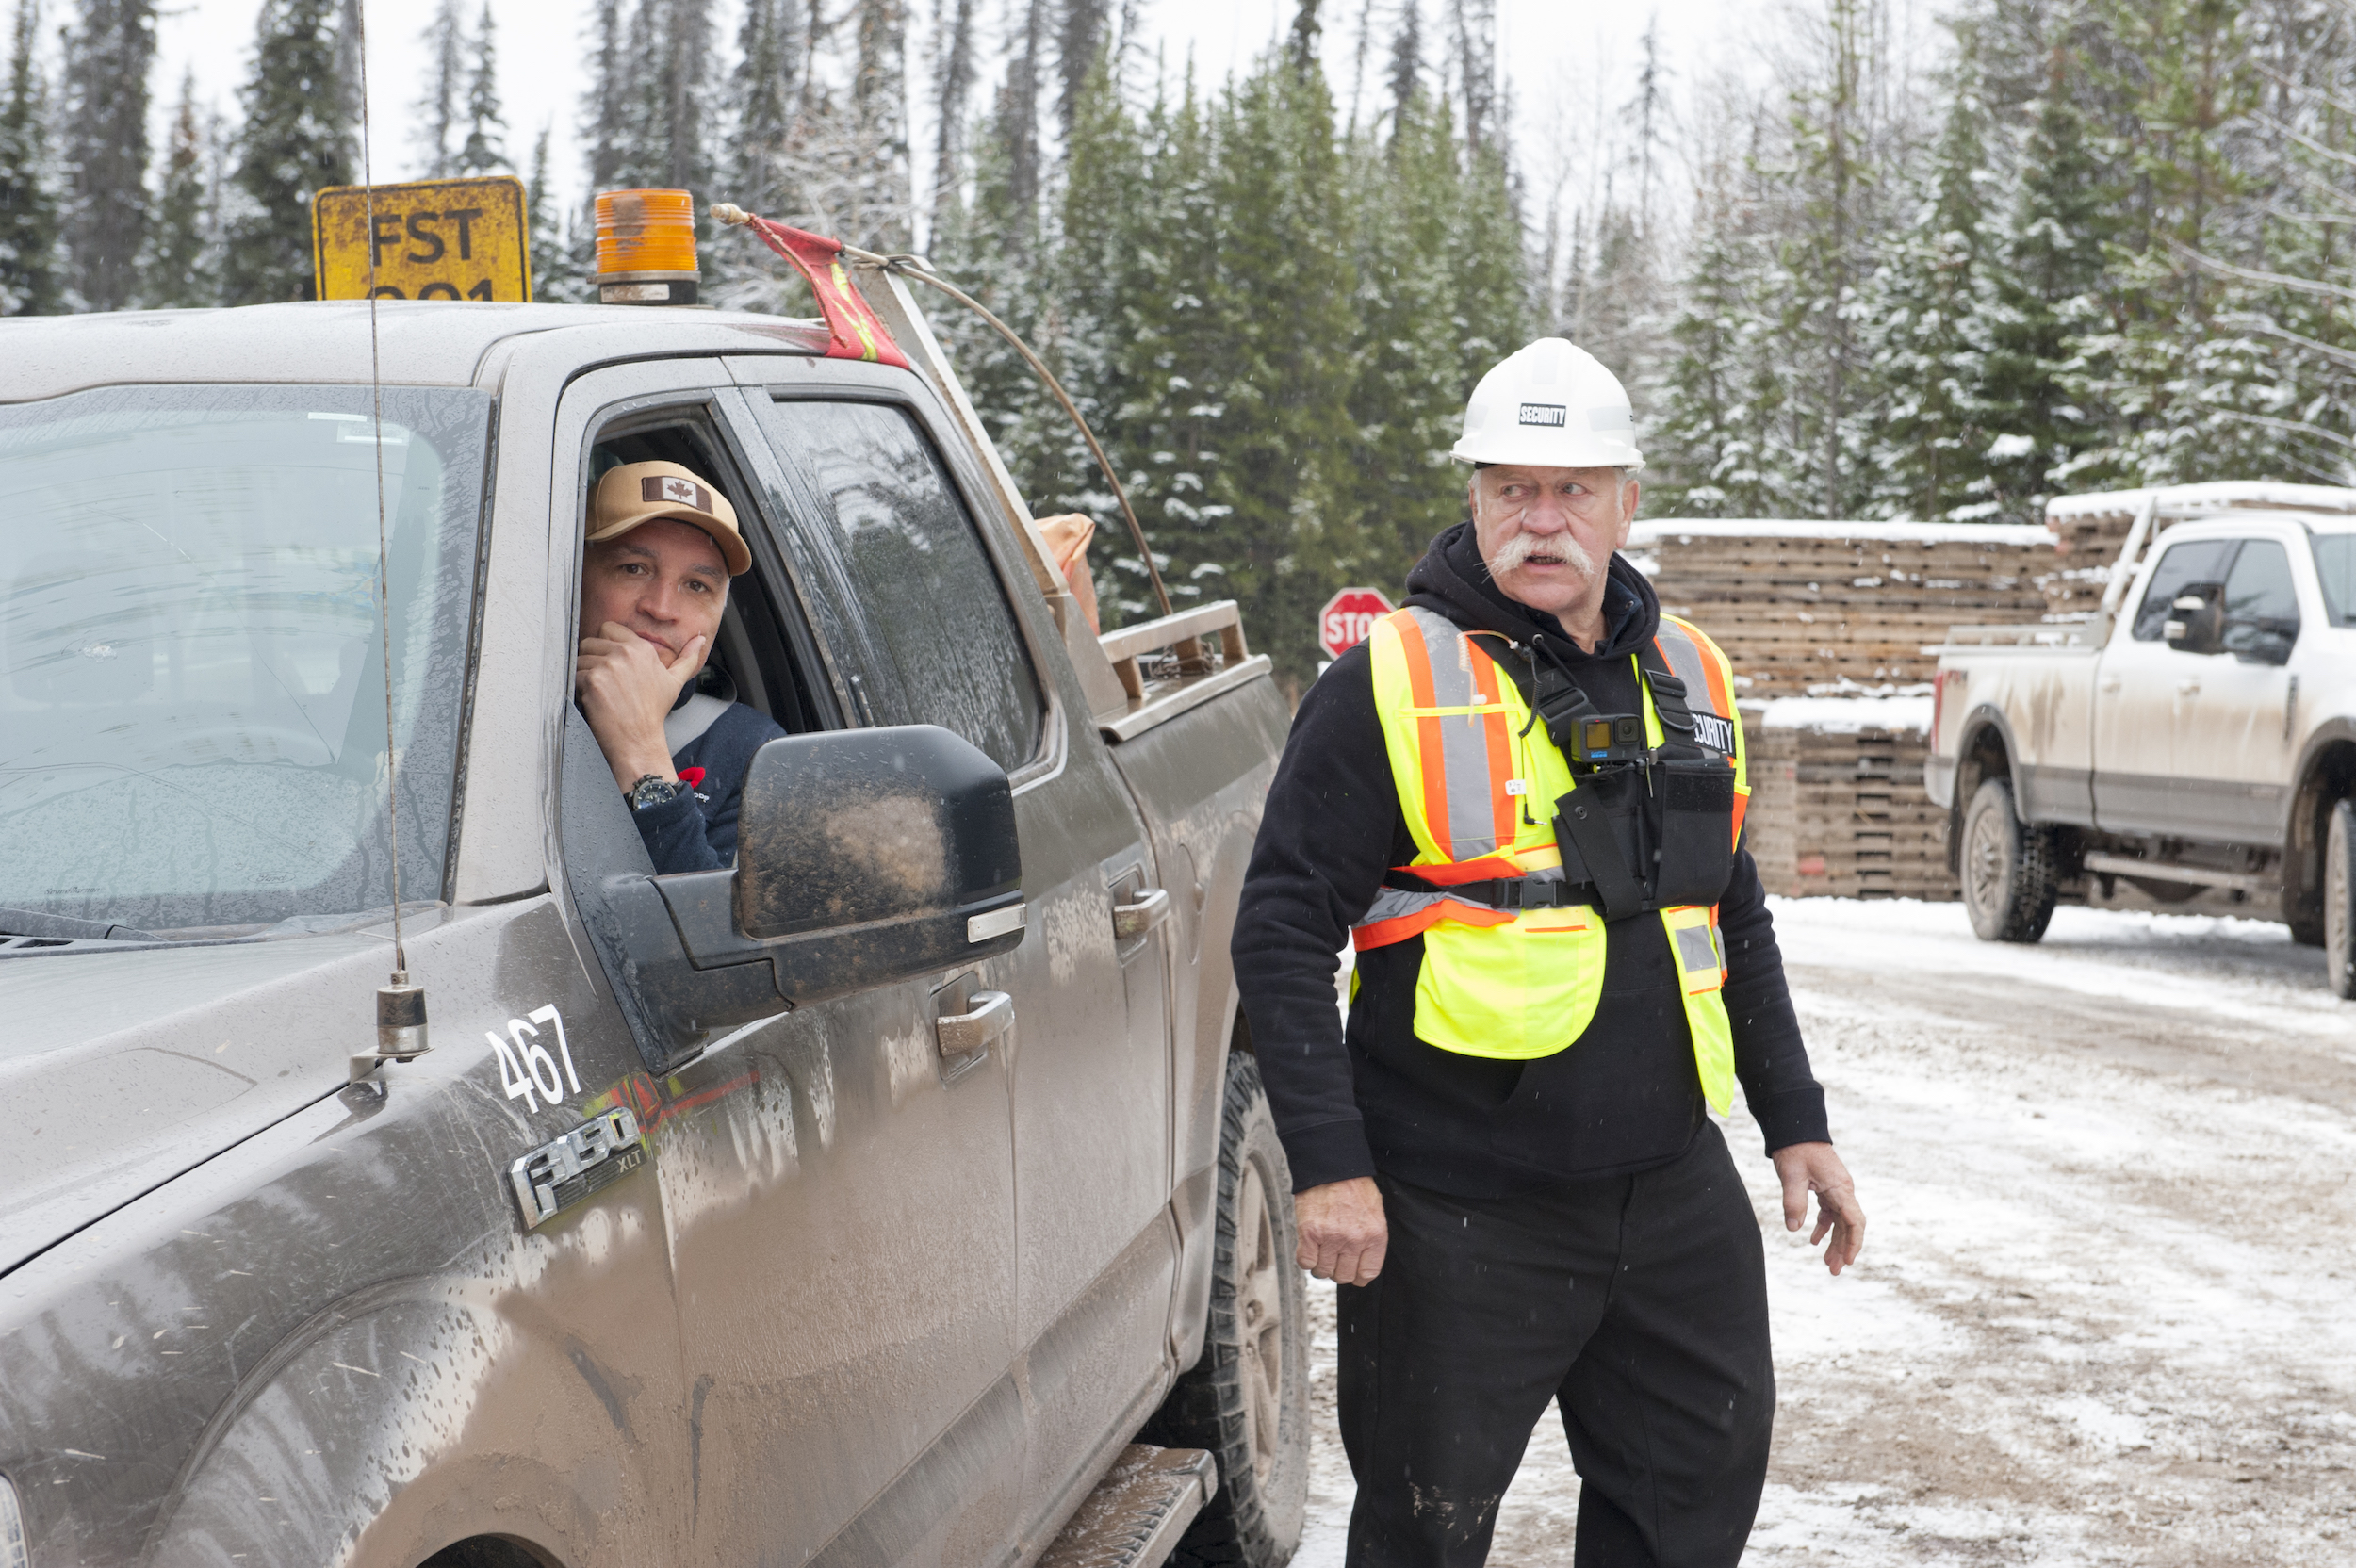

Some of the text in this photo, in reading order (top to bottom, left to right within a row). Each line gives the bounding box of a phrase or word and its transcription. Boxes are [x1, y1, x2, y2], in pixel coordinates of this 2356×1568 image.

[371, 208, 483, 267] FST
[1520, 405, 1565, 425] SECURITY
[1326, 612, 1390, 645] STO
[1692, 713, 1733, 754] CURITY
[485, 1003, 581, 1114] 467
[616, 1149, 642, 1174] XLT
